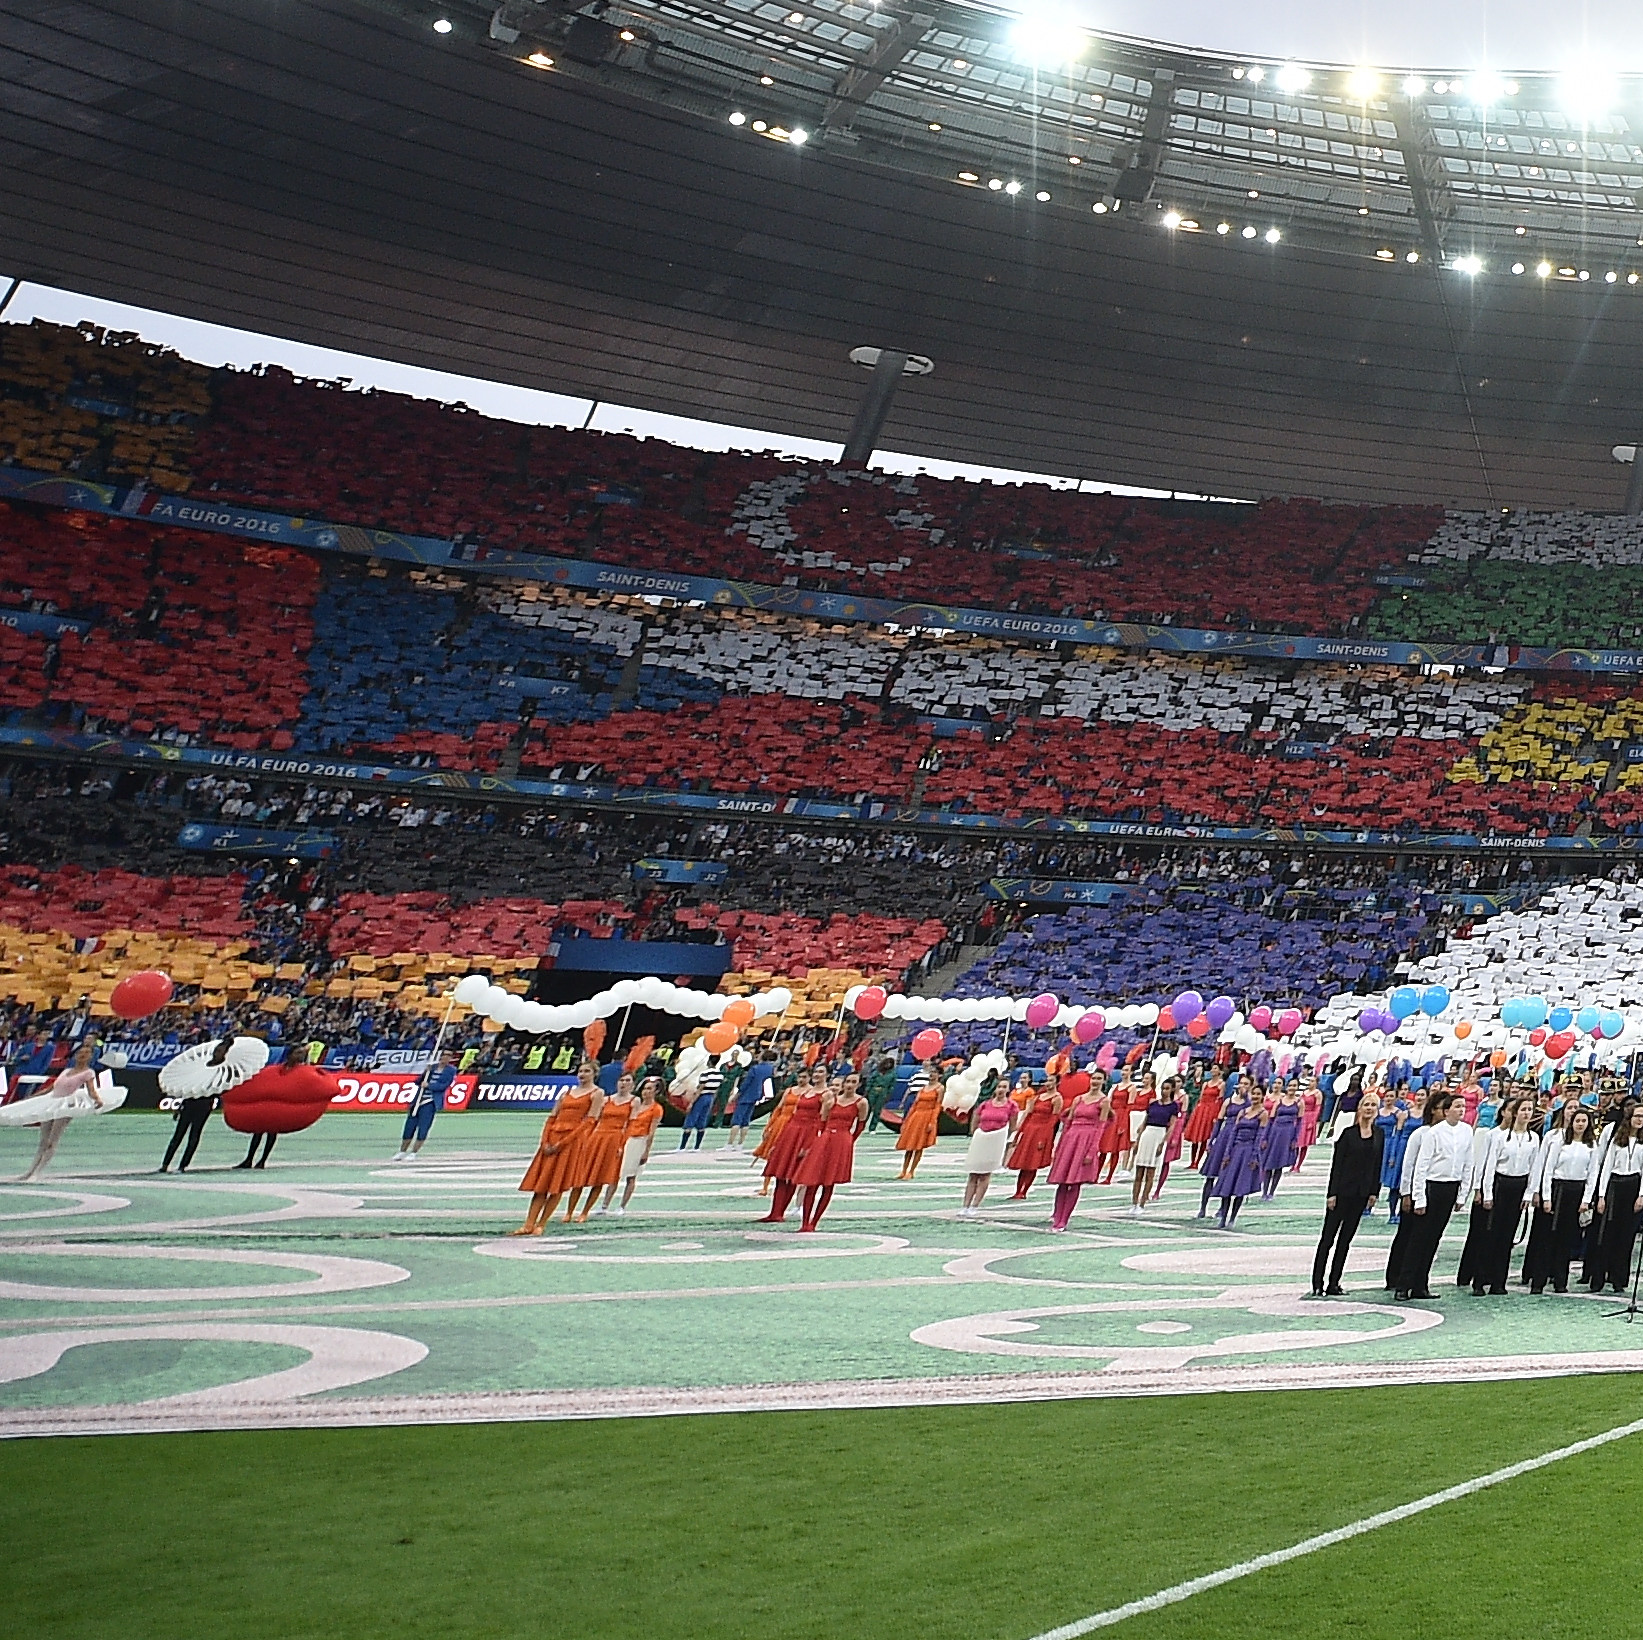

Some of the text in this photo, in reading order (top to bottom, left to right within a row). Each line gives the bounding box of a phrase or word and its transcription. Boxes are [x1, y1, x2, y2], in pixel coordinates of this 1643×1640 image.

[150, 502, 281, 534] FA EURO 2016
[597, 571, 690, 593] SAINT-DENIS
[0, 616, 17, 627] 10
[963, 614, 1078, 636] UEFA EURO 2016
[1317, 644, 1388, 657] SAINT-DENIS
[1604, 655, 1634, 666] UEFA
[1285, 745, 1305, 754] H12
[262, 758, 310, 774] EURO
[312, 764, 358, 778] 2016
[717, 800, 777, 813] SAINT-D
[1109, 825, 1144, 836] UEFA
[1146, 827, 1174, 837] EUR
[1480, 837, 1546, 848] SAINT-DENIS
[703, 873, 717, 881] J2
[331, 1078, 468, 1104] Dona's
[477, 1083, 557, 1101] TURKISH
